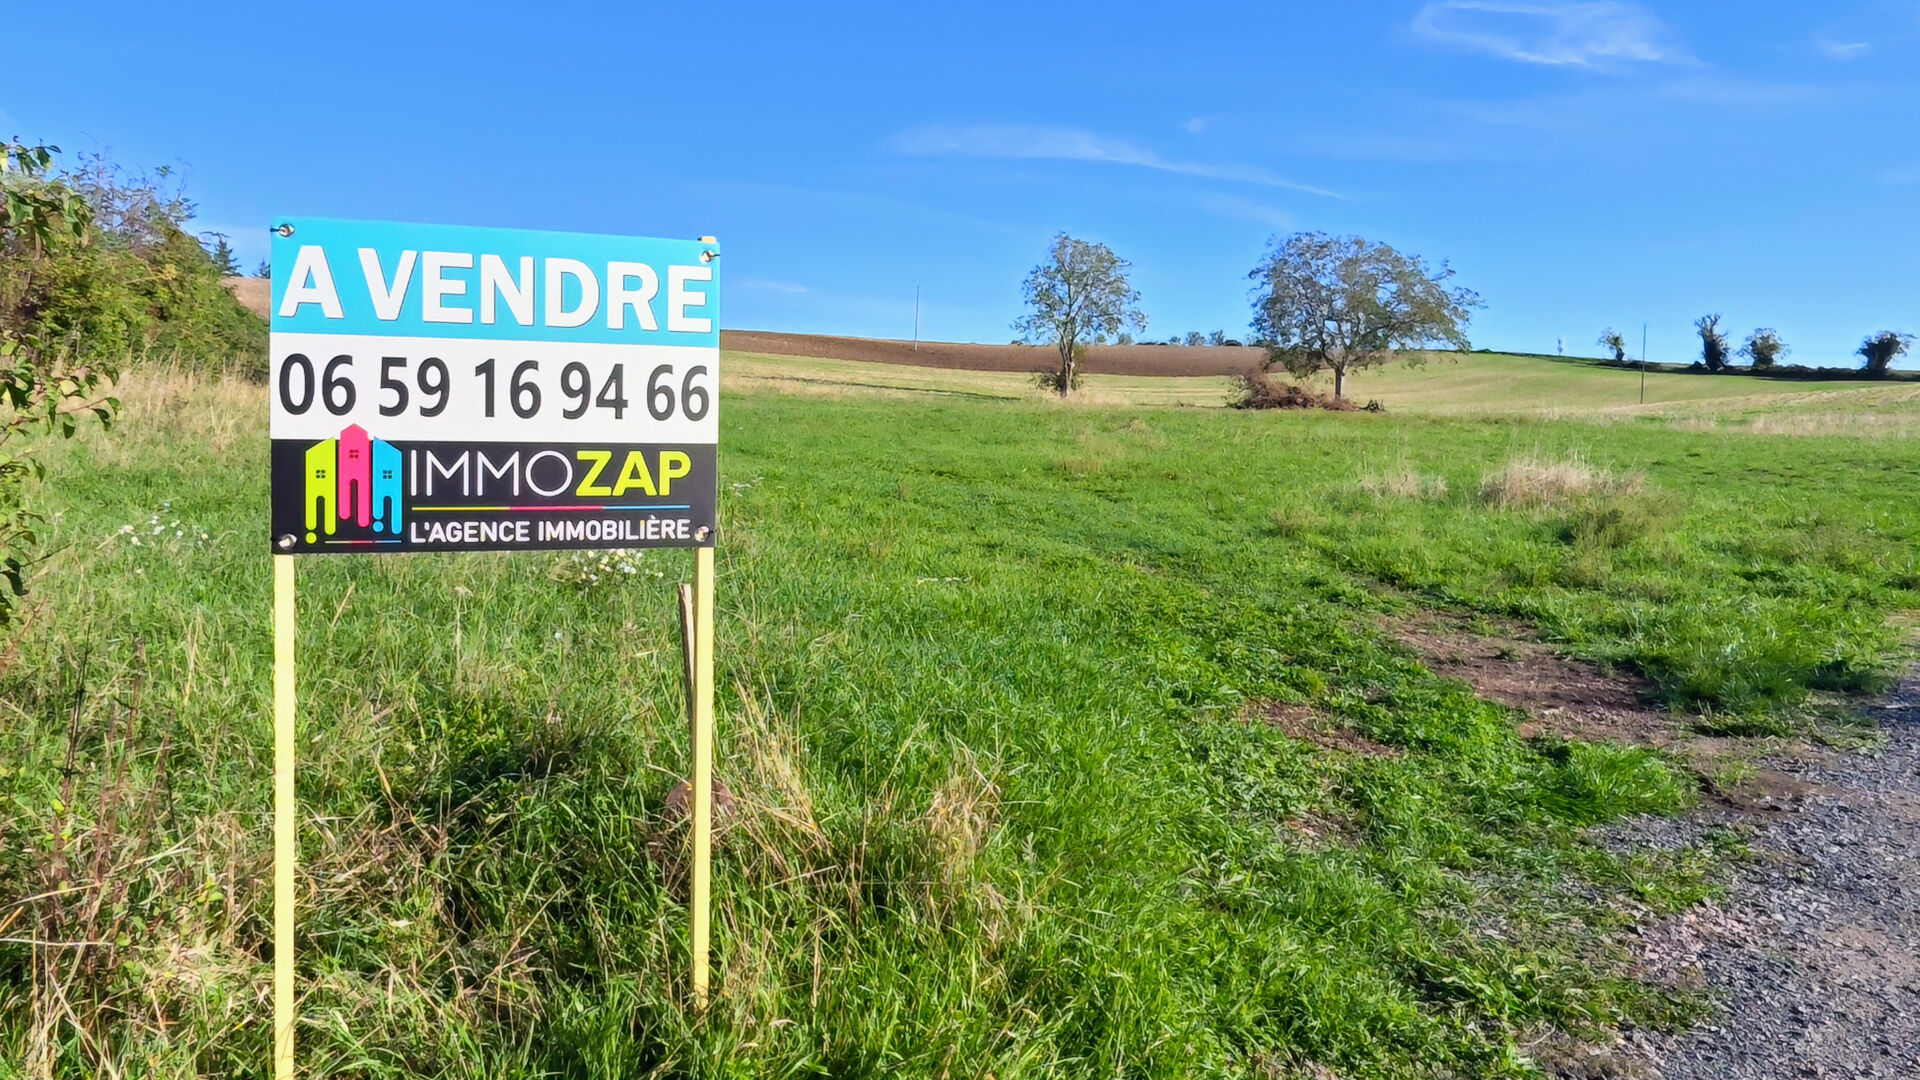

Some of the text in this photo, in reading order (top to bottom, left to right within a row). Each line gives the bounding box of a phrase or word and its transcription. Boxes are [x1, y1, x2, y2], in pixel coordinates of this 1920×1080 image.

[278, 245, 713, 333] A VENDRE
[279, 353, 710, 421] 06 59 16 94 66
[410, 449, 692, 497] IMMOZAP
[410, 514, 691, 543] L'AGENCE IMMOBILIÈRE
